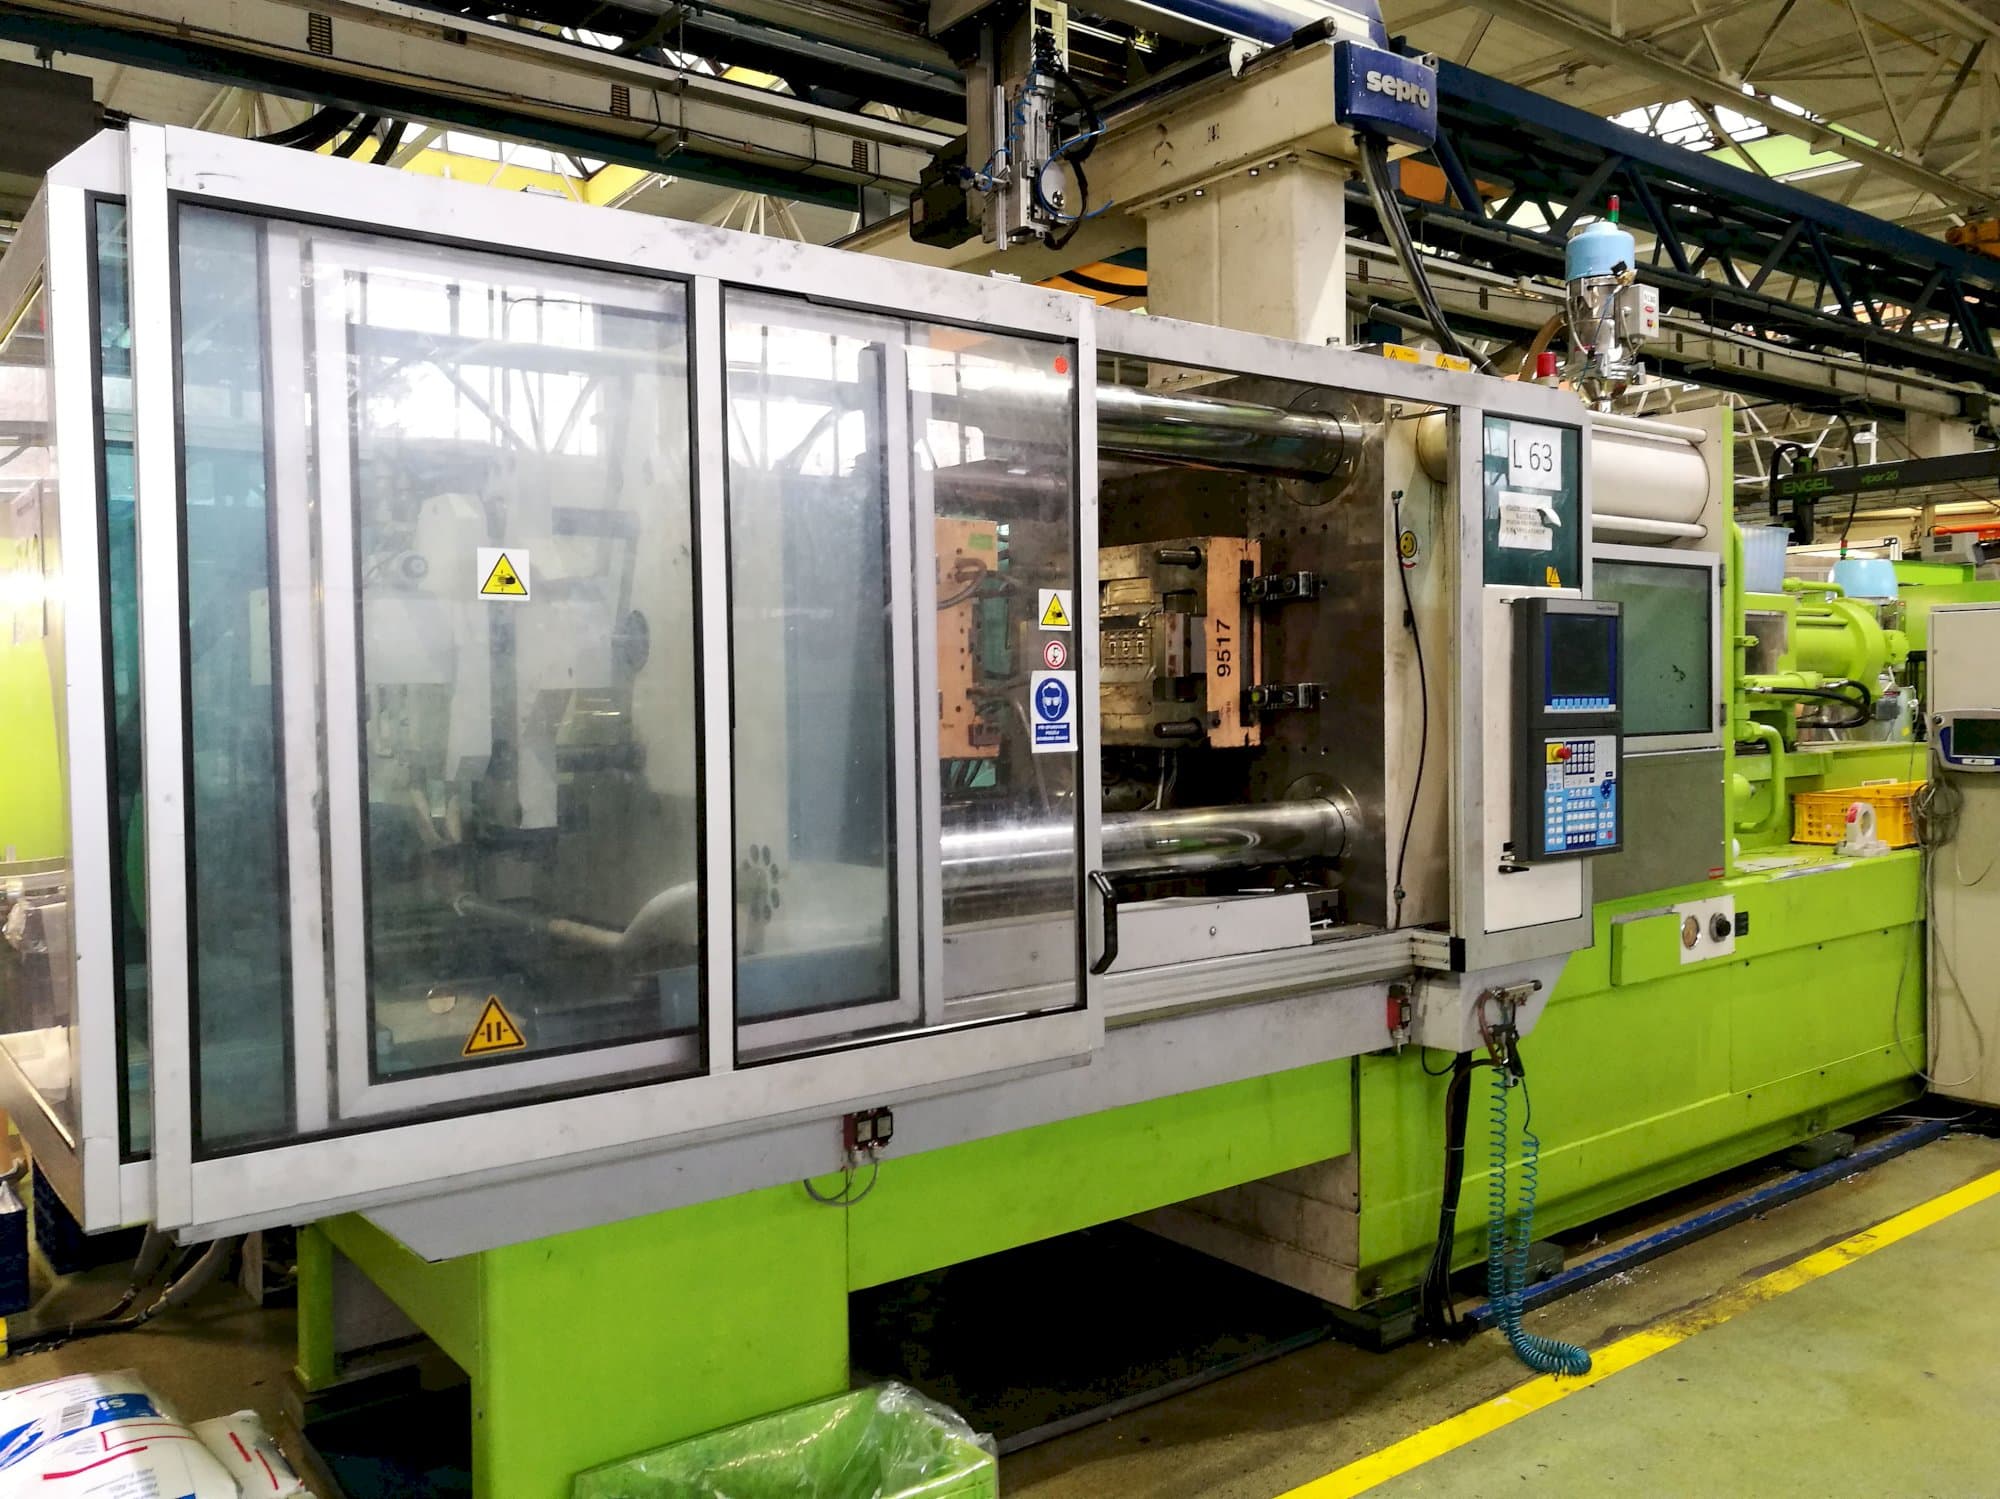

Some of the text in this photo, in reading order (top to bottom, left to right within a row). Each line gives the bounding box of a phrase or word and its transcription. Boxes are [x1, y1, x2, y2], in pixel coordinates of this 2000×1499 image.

[1366, 70, 1430, 109] sepro
[1513, 439, 1553, 472] L 63
[1783, 478, 1834, 494] ENGEL
[1216, 618, 1231, 677] 9517
